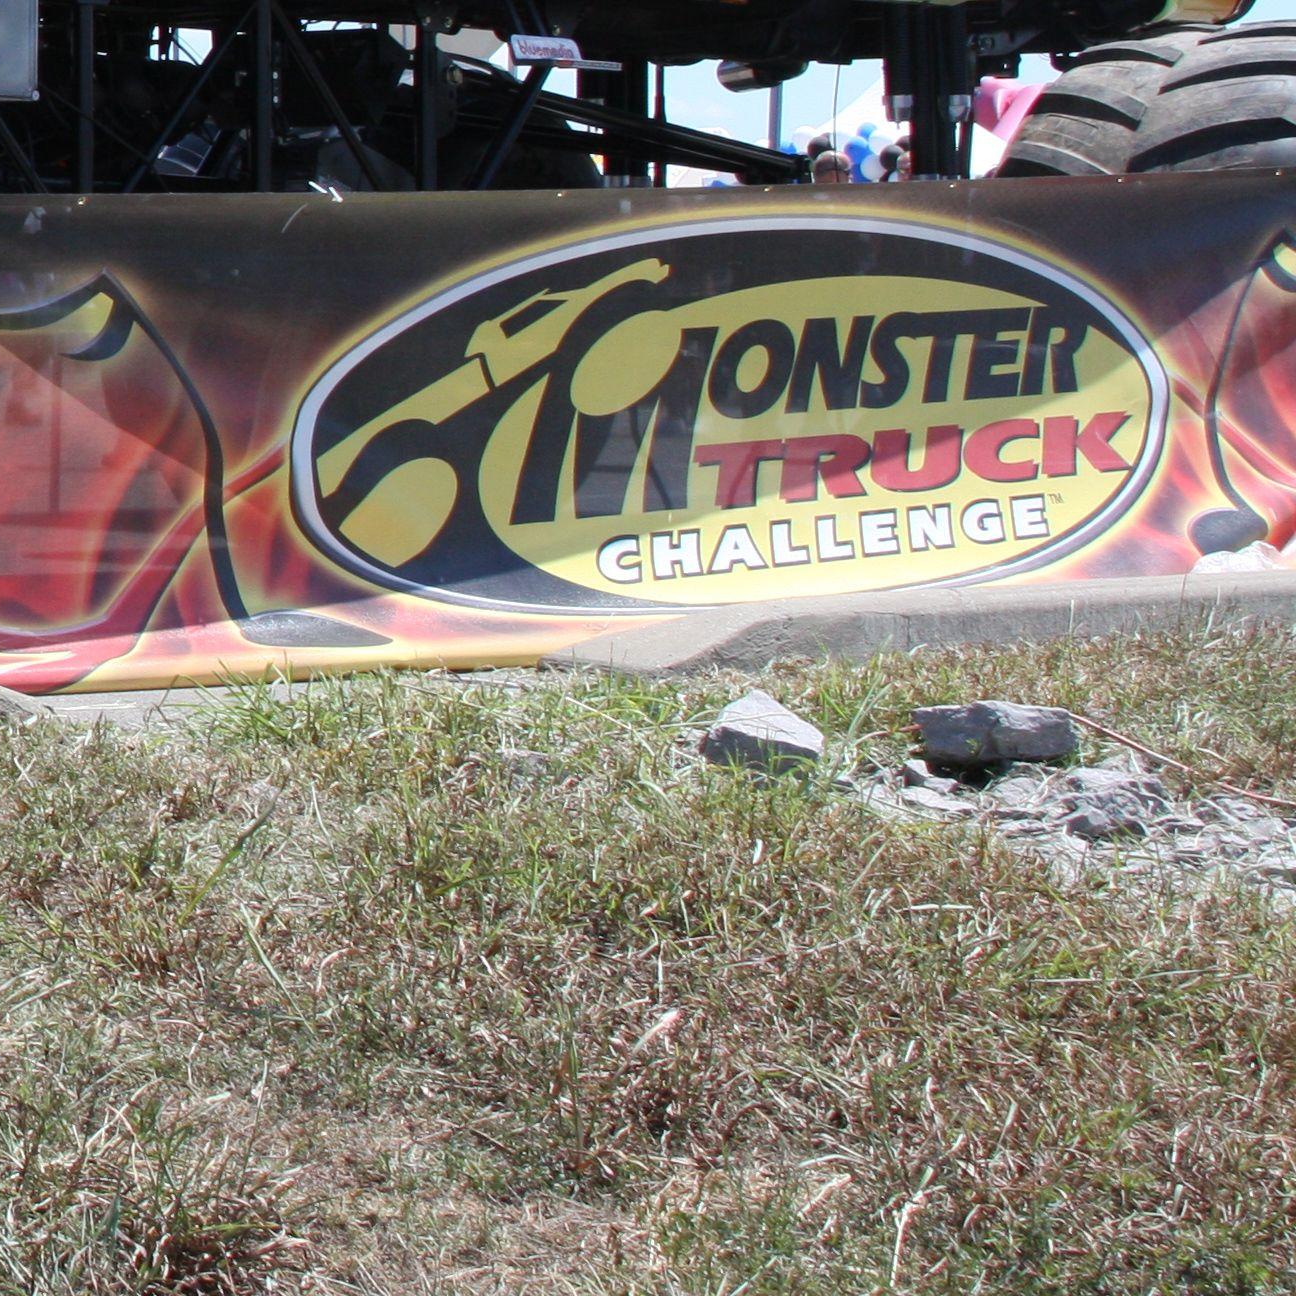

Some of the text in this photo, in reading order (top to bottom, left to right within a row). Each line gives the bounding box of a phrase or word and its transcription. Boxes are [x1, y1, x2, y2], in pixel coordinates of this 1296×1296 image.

[510, 304, 1091, 526] MONSTER
[693, 410, 1133, 508] TRUCK
[596, 493, 1049, 584] CHALLENGE
